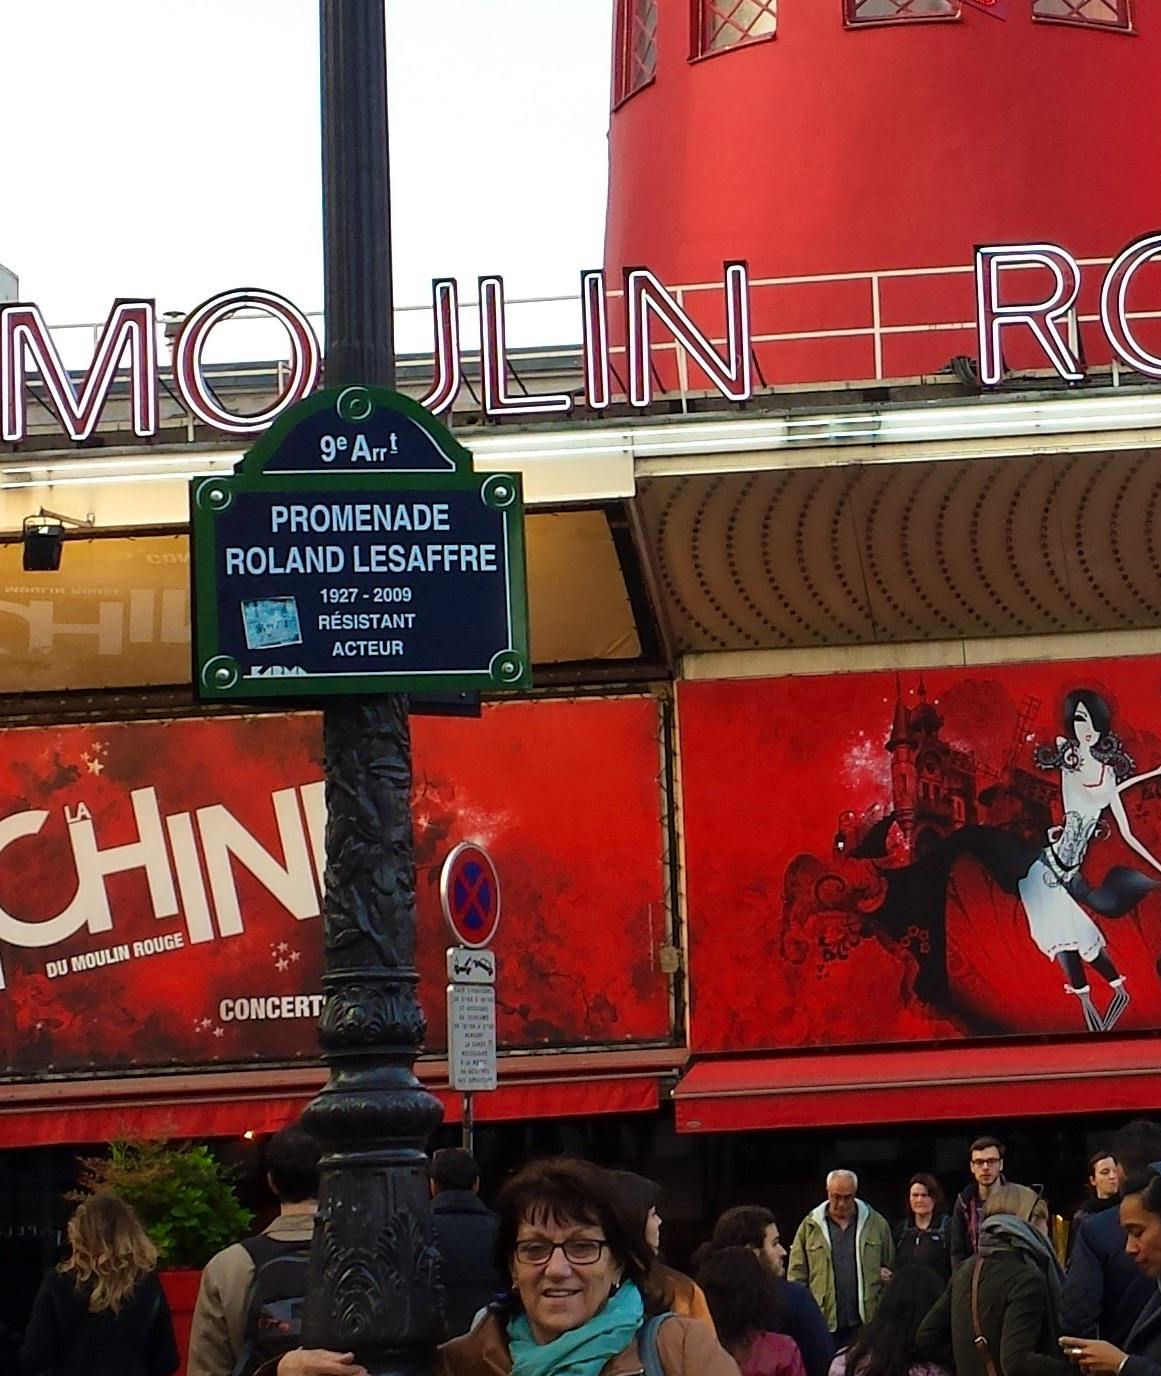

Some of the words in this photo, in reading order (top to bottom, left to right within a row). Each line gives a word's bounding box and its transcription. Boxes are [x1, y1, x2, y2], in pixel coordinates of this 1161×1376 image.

[271, 504, 451, 533] PROMENADE
[225, 546, 346, 575] ROLAND
[353, 544, 497, 573] LESAFFRE
[320, 588, 357, 603] 1927
[373, 587, 413, 603] 2009
[318, 611, 416, 630] RÉSISTANT
[332, 640, 405, 657] ACTEUR
[64, 801, 92, 824] LA
[0, 780, 327, 948] CHIN
[46, 960, 69, 979] DU
[71, 944, 130, 974] MOULIN
[133, 932, 185, 960] ROUGE
[219, 994, 327, 1022] CONCERT
